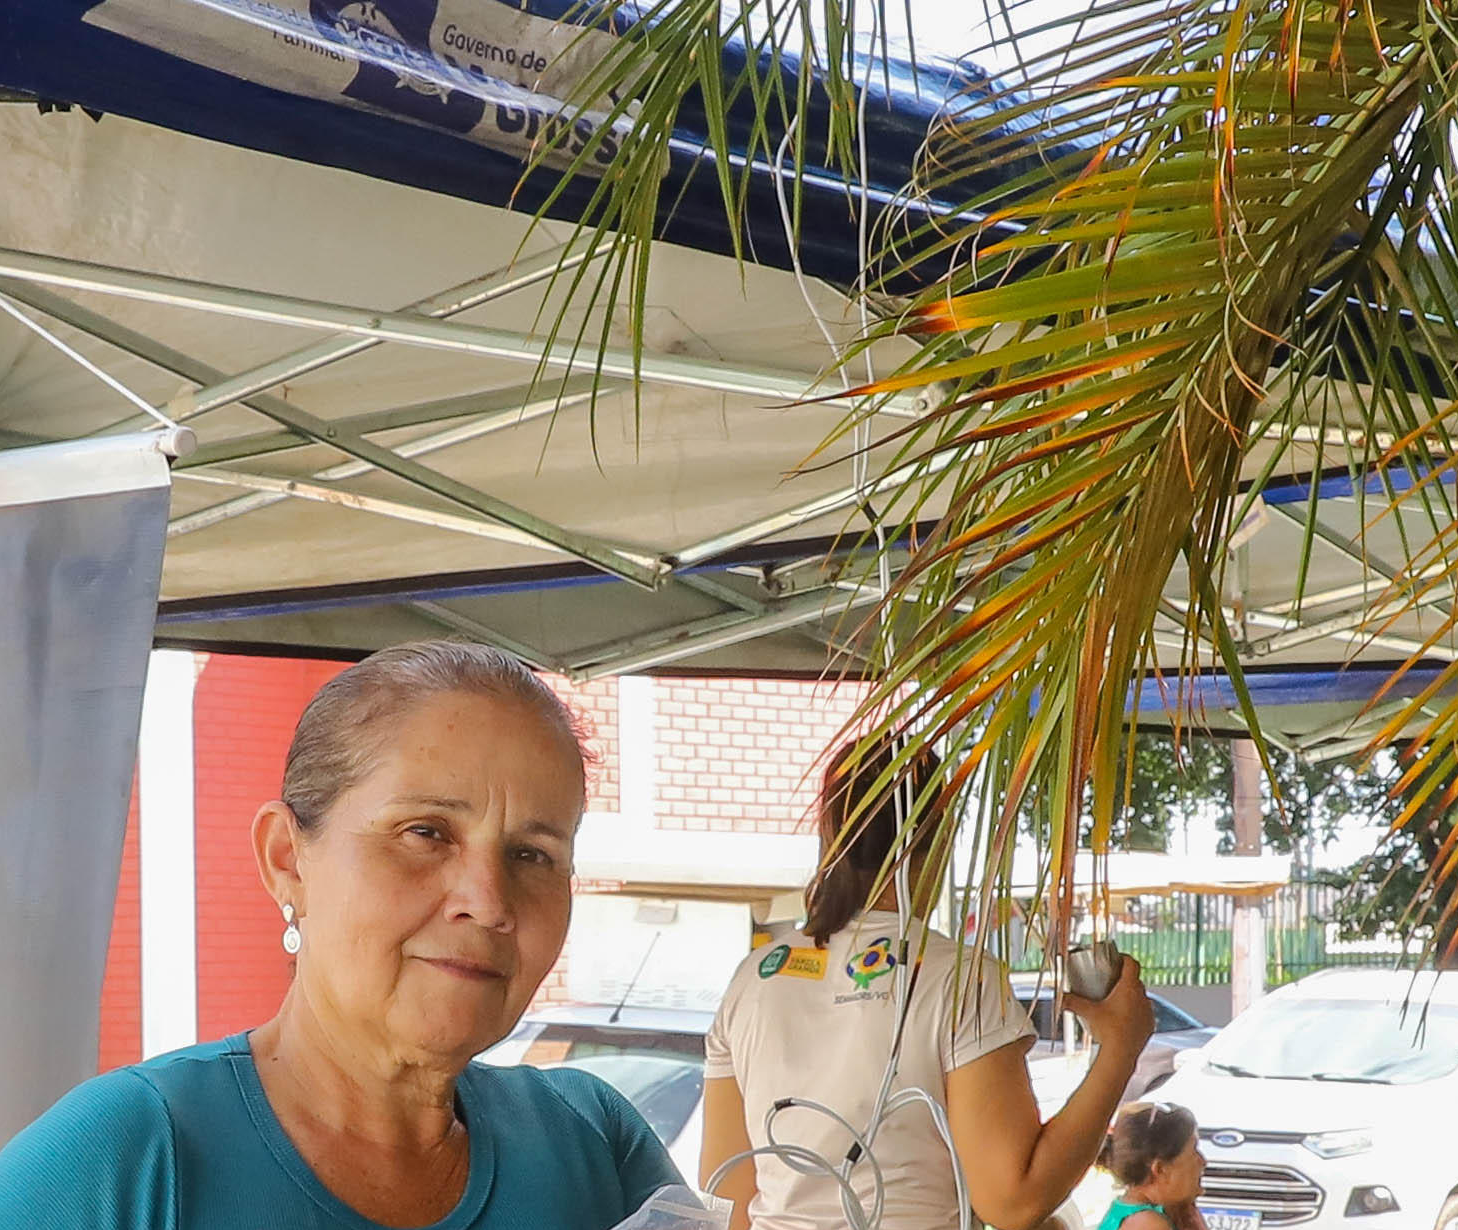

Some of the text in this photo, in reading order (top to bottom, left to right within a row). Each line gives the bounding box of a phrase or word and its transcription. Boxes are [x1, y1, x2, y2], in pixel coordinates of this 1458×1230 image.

[443, 24, 547, 73] Governo de
[495, 102, 633, 166] Gross
